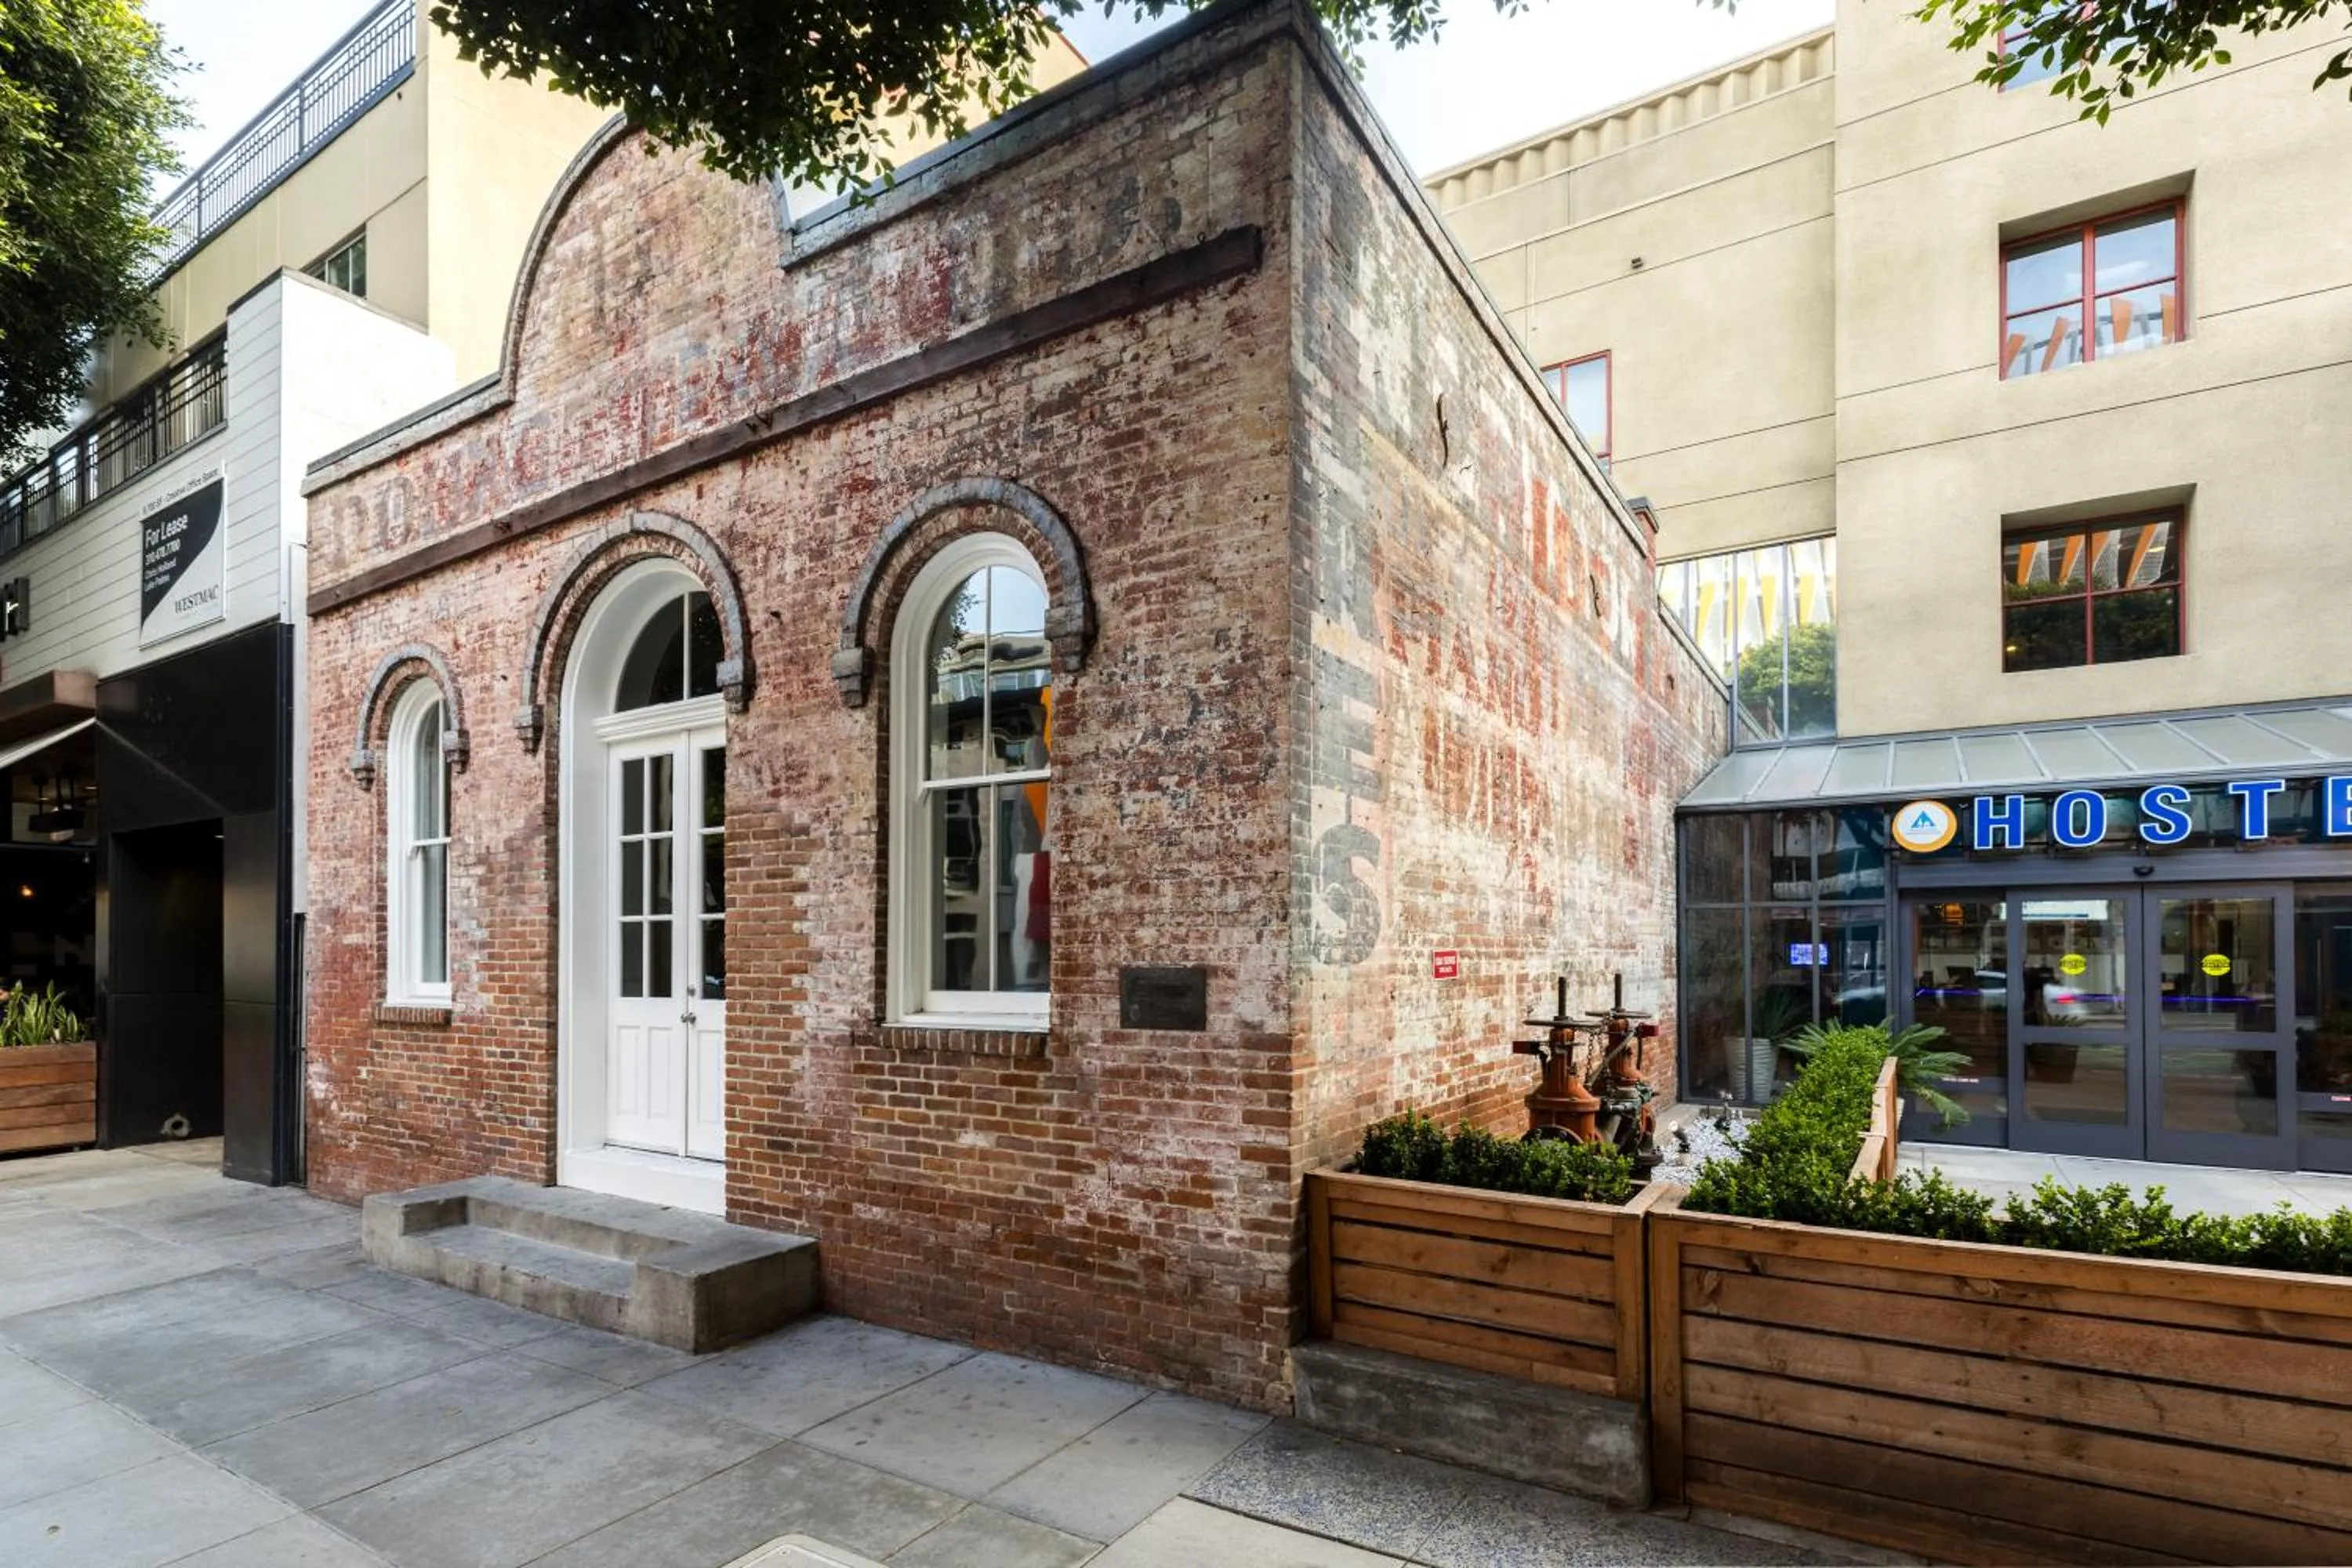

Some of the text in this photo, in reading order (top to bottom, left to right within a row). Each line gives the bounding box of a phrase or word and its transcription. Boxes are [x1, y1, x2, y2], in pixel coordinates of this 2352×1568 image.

[145, 514, 188, 549] For Lease
[175, 584, 219, 614] WESTMAC
